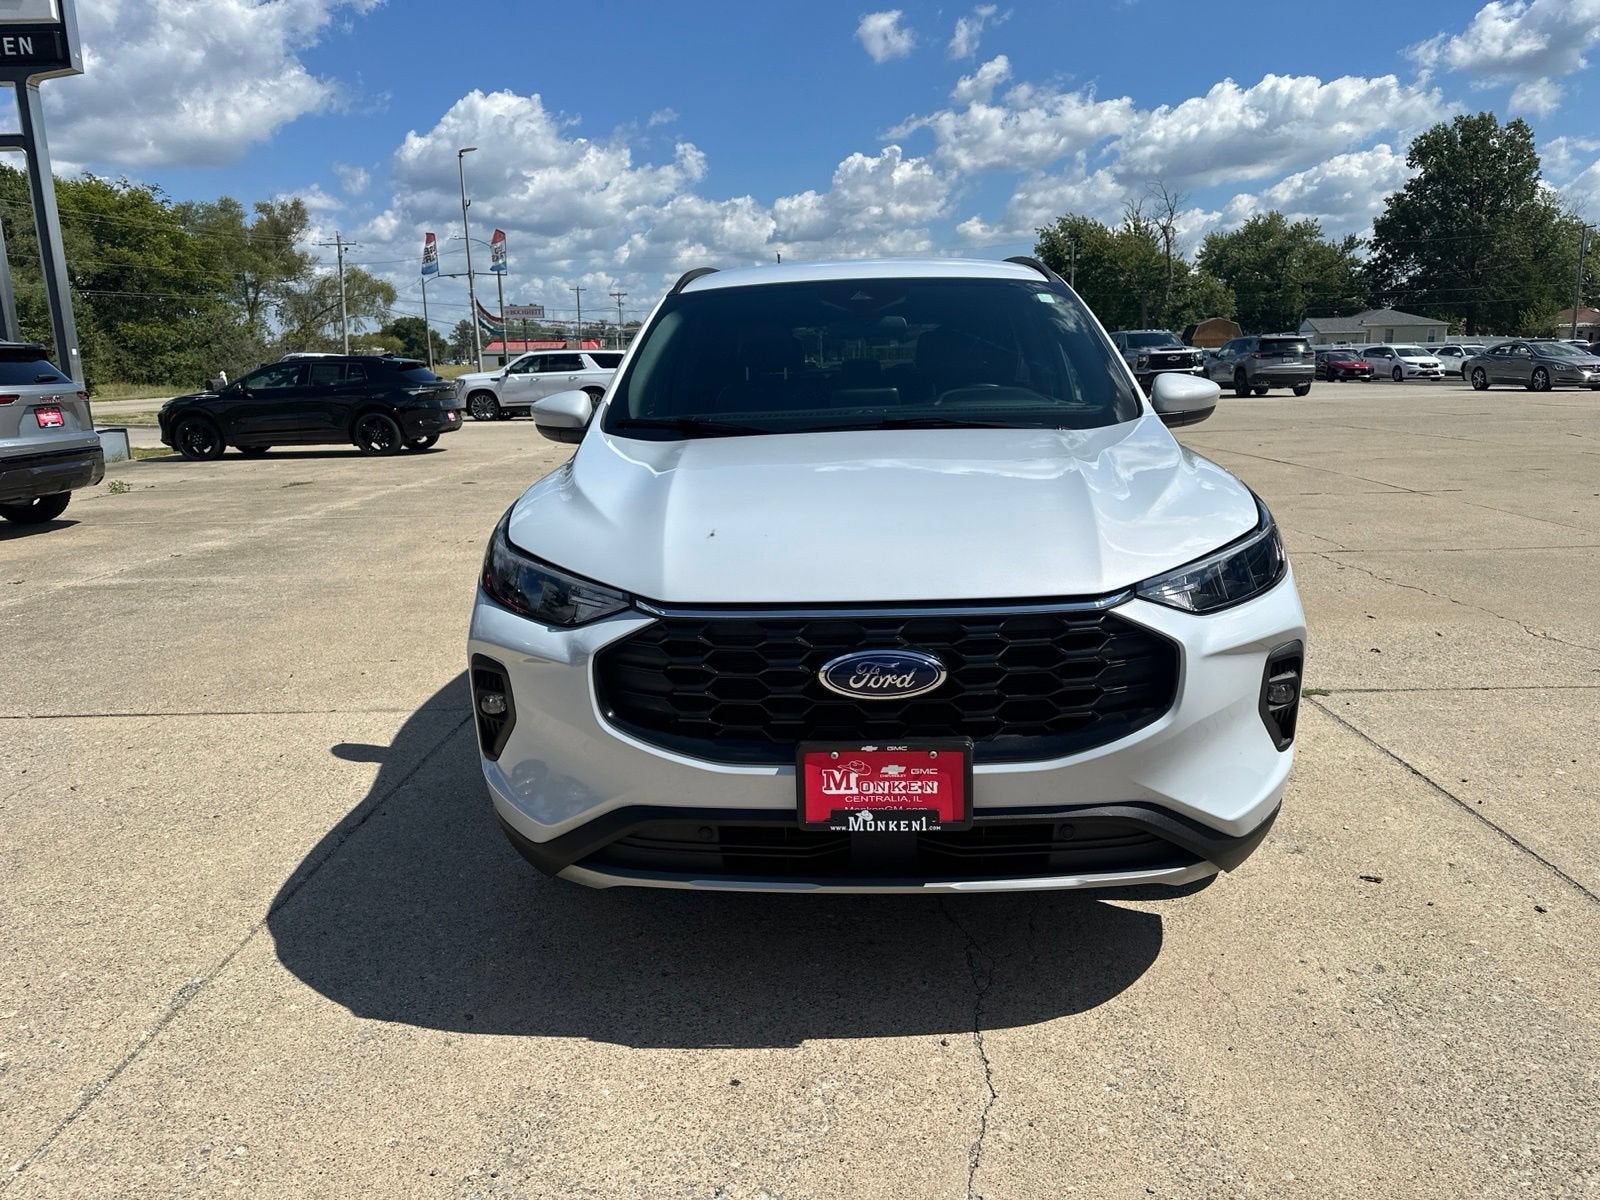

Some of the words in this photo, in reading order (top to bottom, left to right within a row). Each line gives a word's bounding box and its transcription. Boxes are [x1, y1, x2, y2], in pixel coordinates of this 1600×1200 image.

[0, 36, 33, 55] EN
[849, 661, 917, 688] Ford
[822, 769, 938, 794] MONKEN
[845, 795, 911, 803] CENTRALIA,
